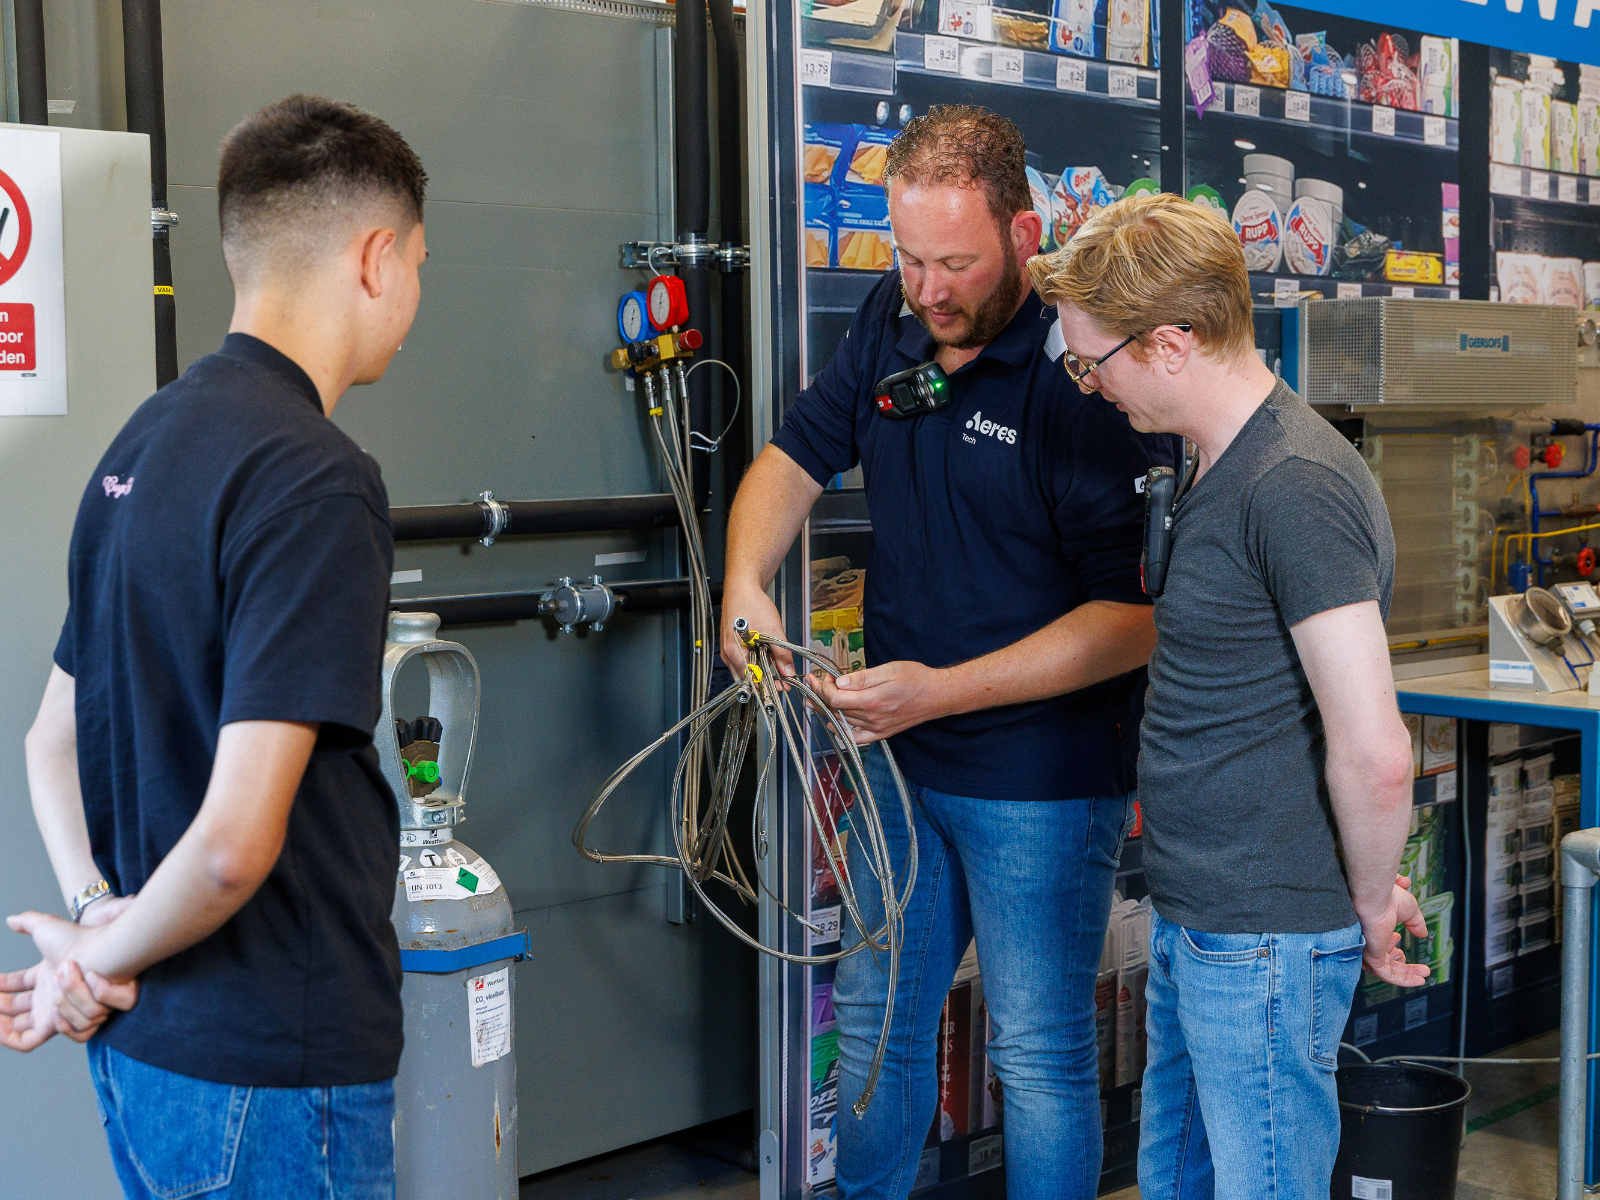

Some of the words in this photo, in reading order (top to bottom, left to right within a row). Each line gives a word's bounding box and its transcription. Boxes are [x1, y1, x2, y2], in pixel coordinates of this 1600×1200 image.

[939, 49, 957, 60] 8.29
[805, 62, 828, 75] 13.79
[1005, 61, 1021, 72] 8.29
[1245, 223, 1269, 239] RUPP
[1298, 222, 1320, 250] RUPP
[965, 411, 1018, 444] Aeres
[962, 432, 977, 445] Tech
[424, 853, 436, 866] T
[411, 884, 423, 892] UN
